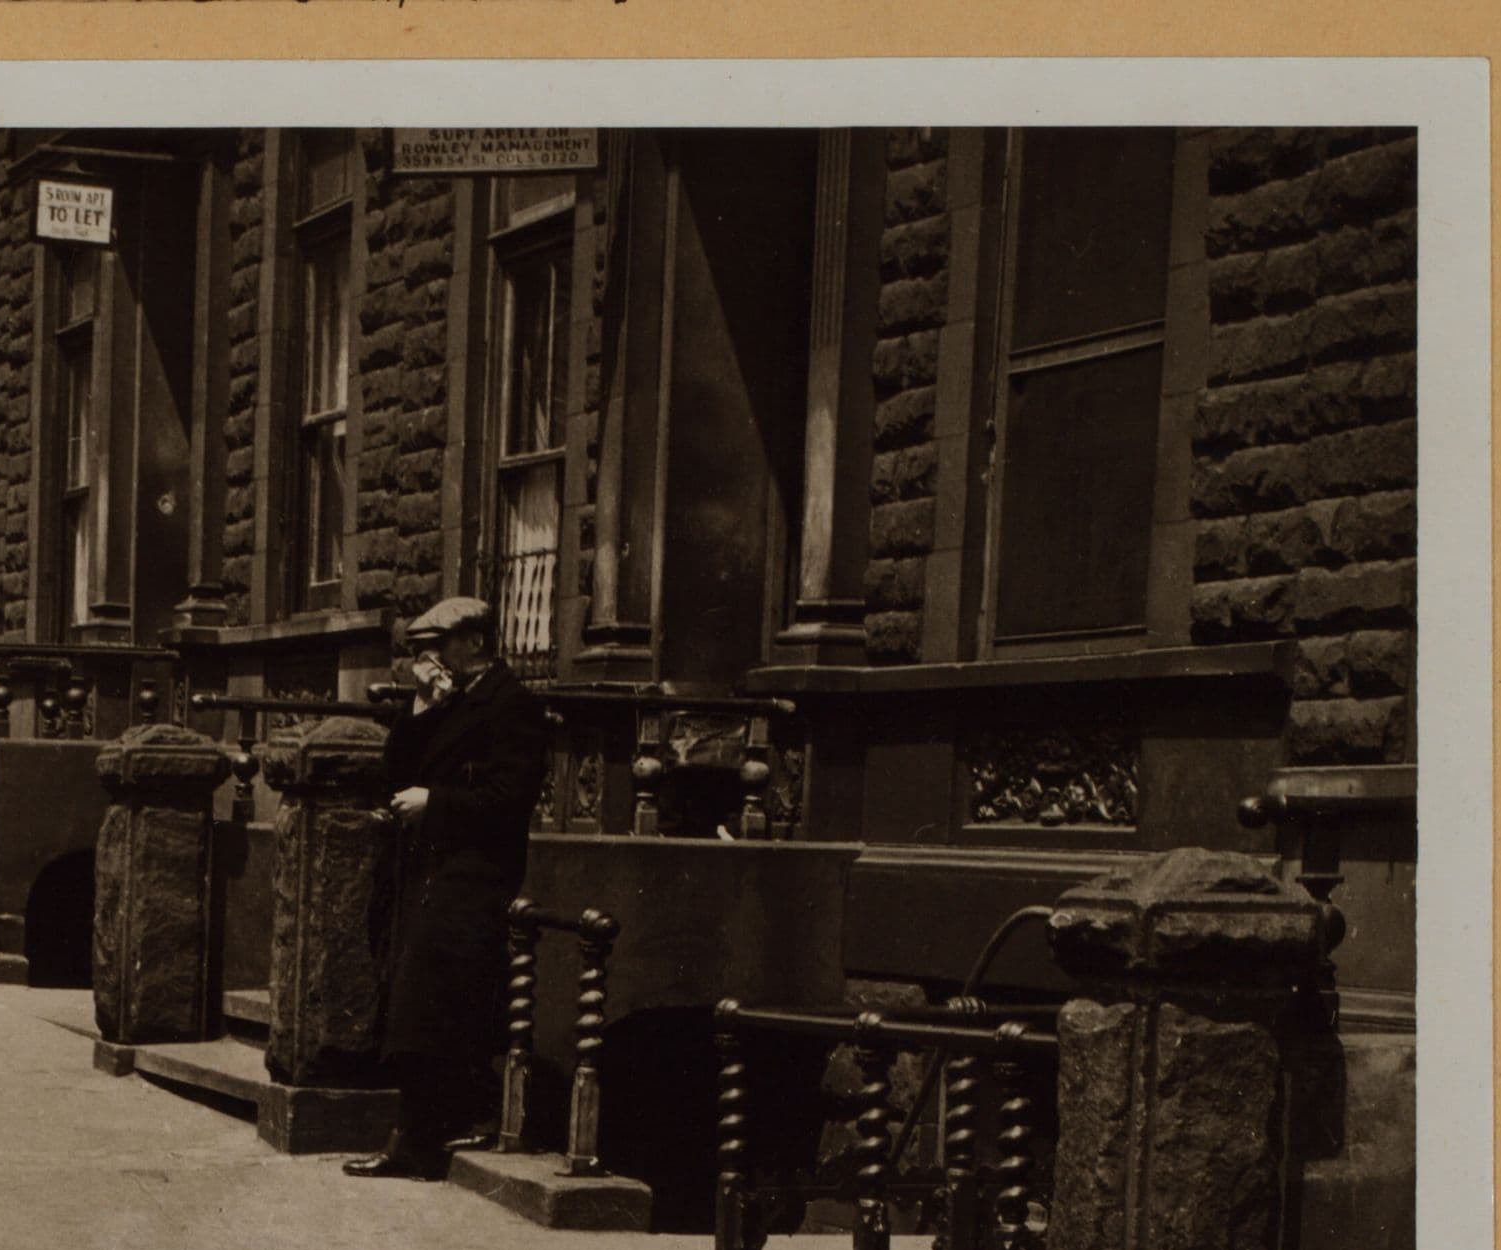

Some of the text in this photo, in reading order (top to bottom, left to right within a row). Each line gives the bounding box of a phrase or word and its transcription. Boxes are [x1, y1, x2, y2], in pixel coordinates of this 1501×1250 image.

[481, 139, 590, 153] MANAGEMENT
[49, 206, 104, 226] TO LET
